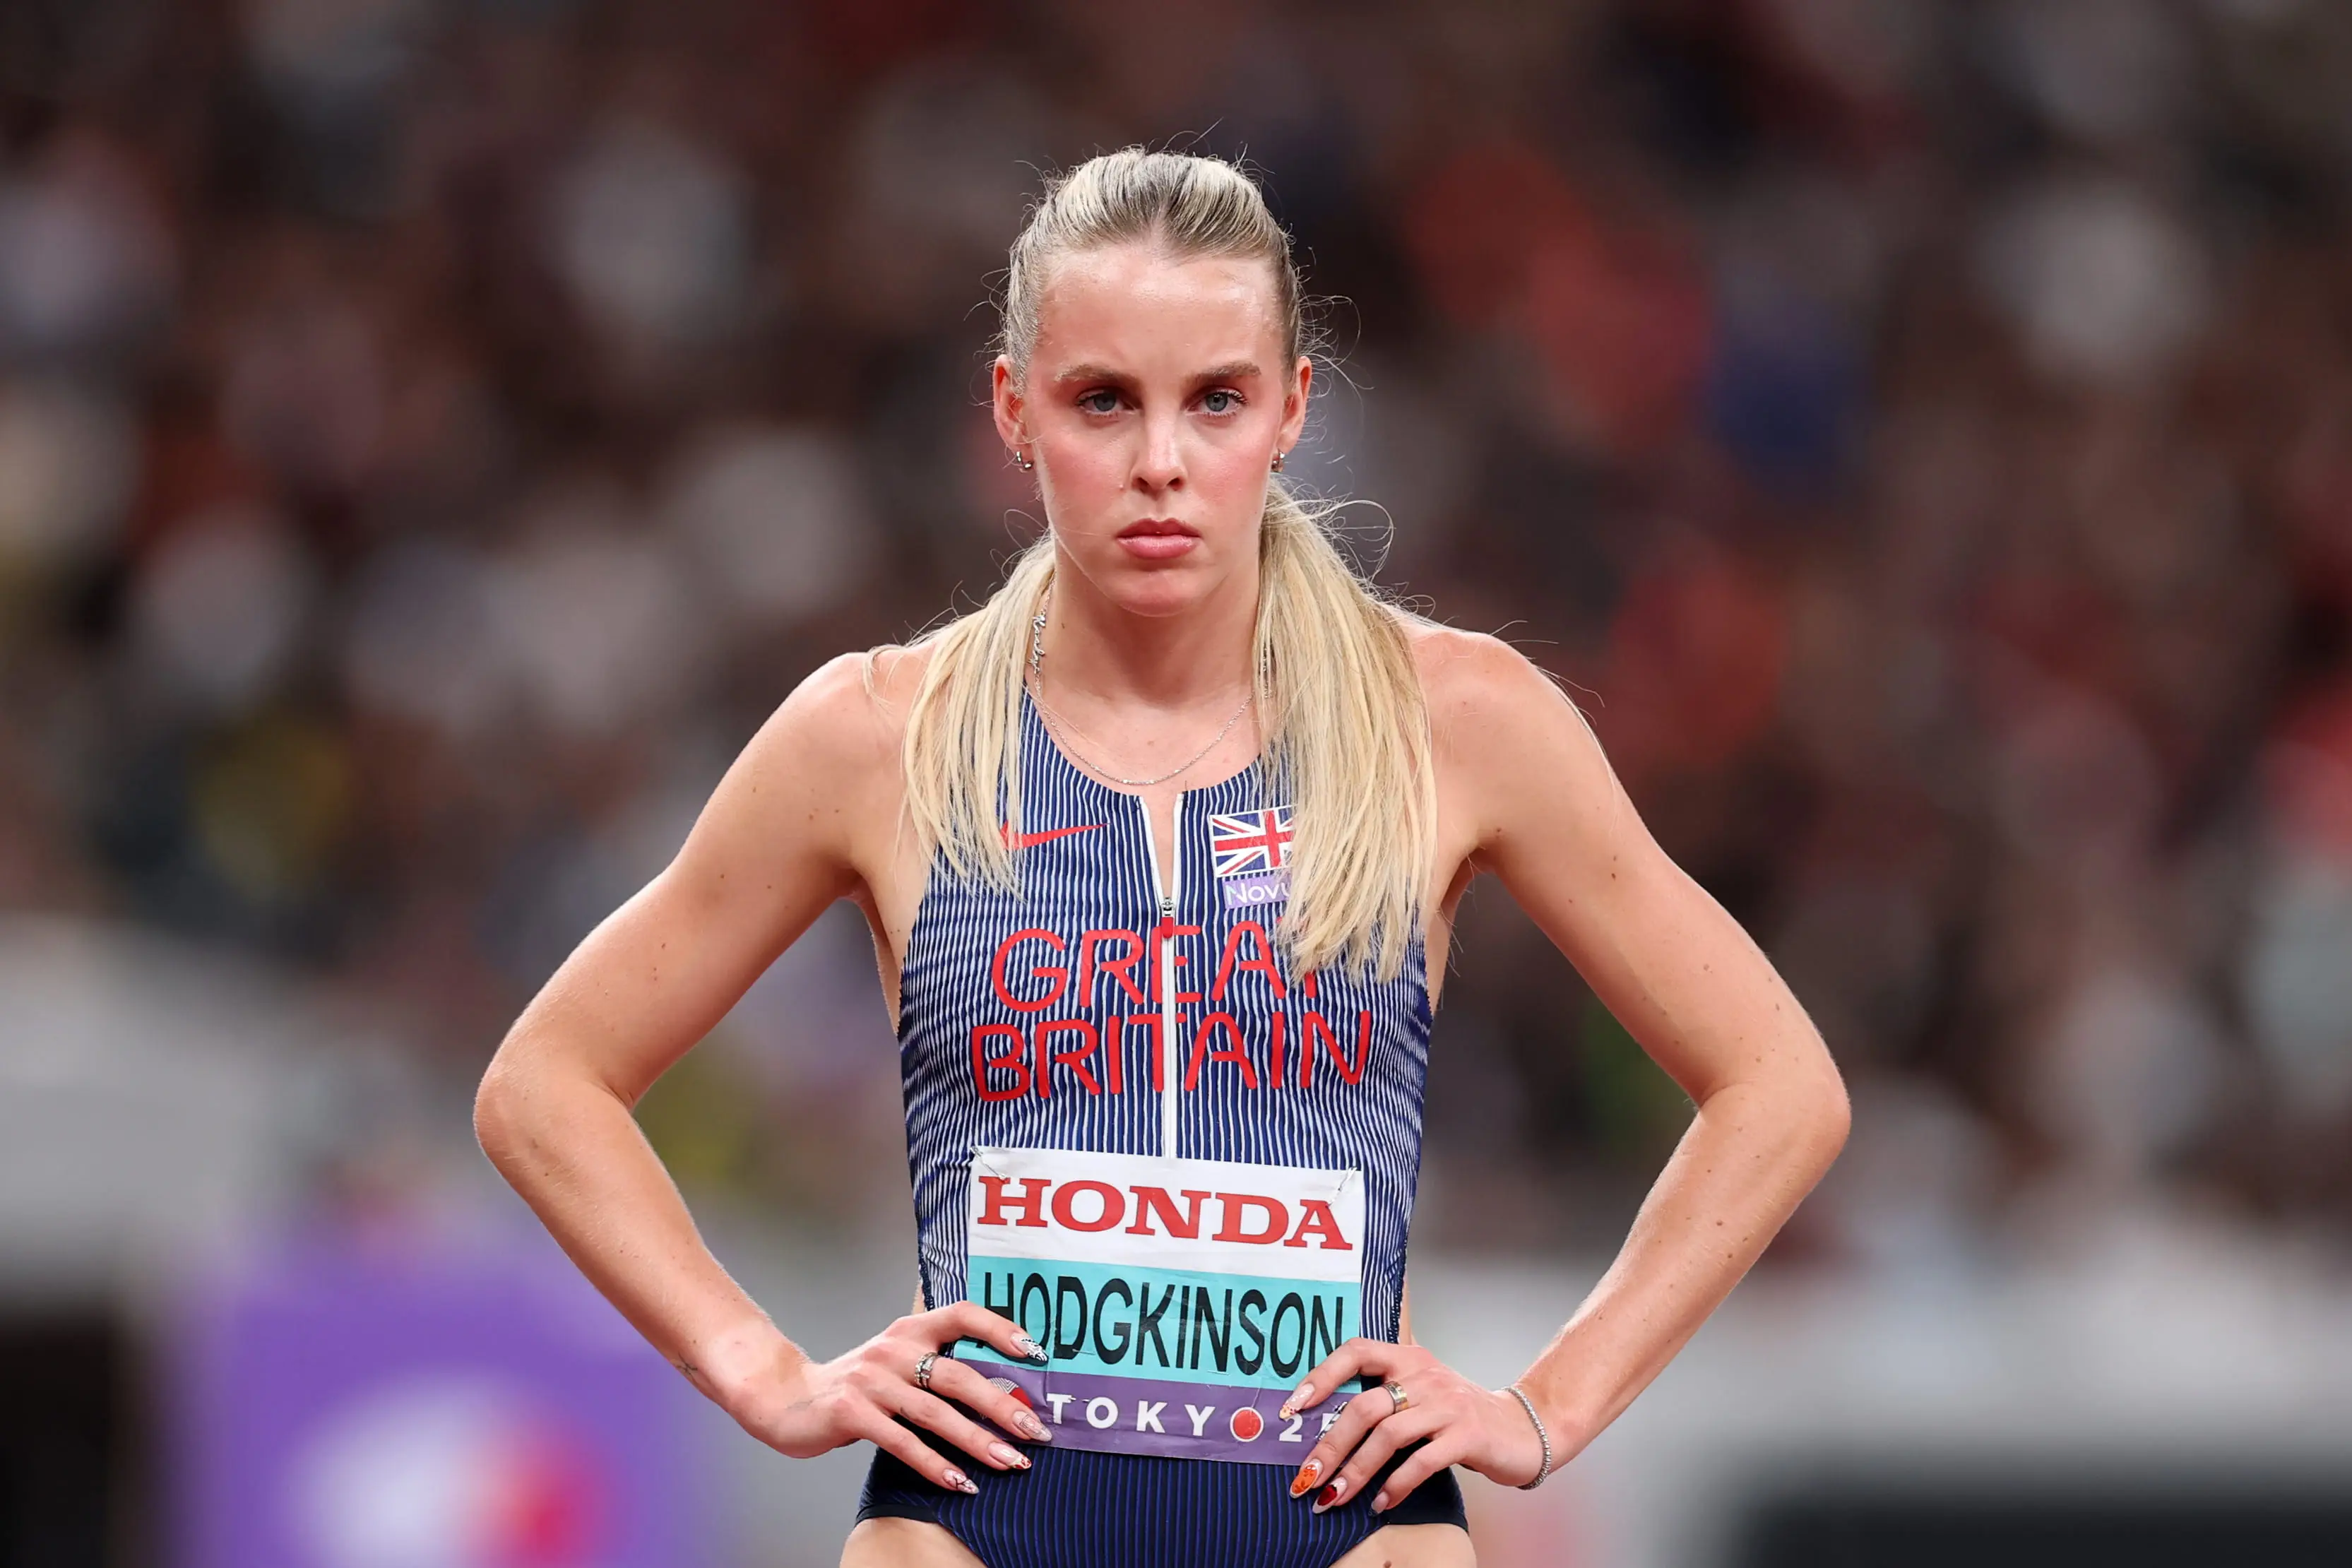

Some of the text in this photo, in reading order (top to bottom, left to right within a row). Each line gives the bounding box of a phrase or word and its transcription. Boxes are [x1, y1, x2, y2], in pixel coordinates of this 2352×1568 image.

[971, 1010, 1371, 1101] BRITAIN
[977, 1175, 1353, 1251] HONDA
[976, 1272, 1343, 1378] HODGKINSON
